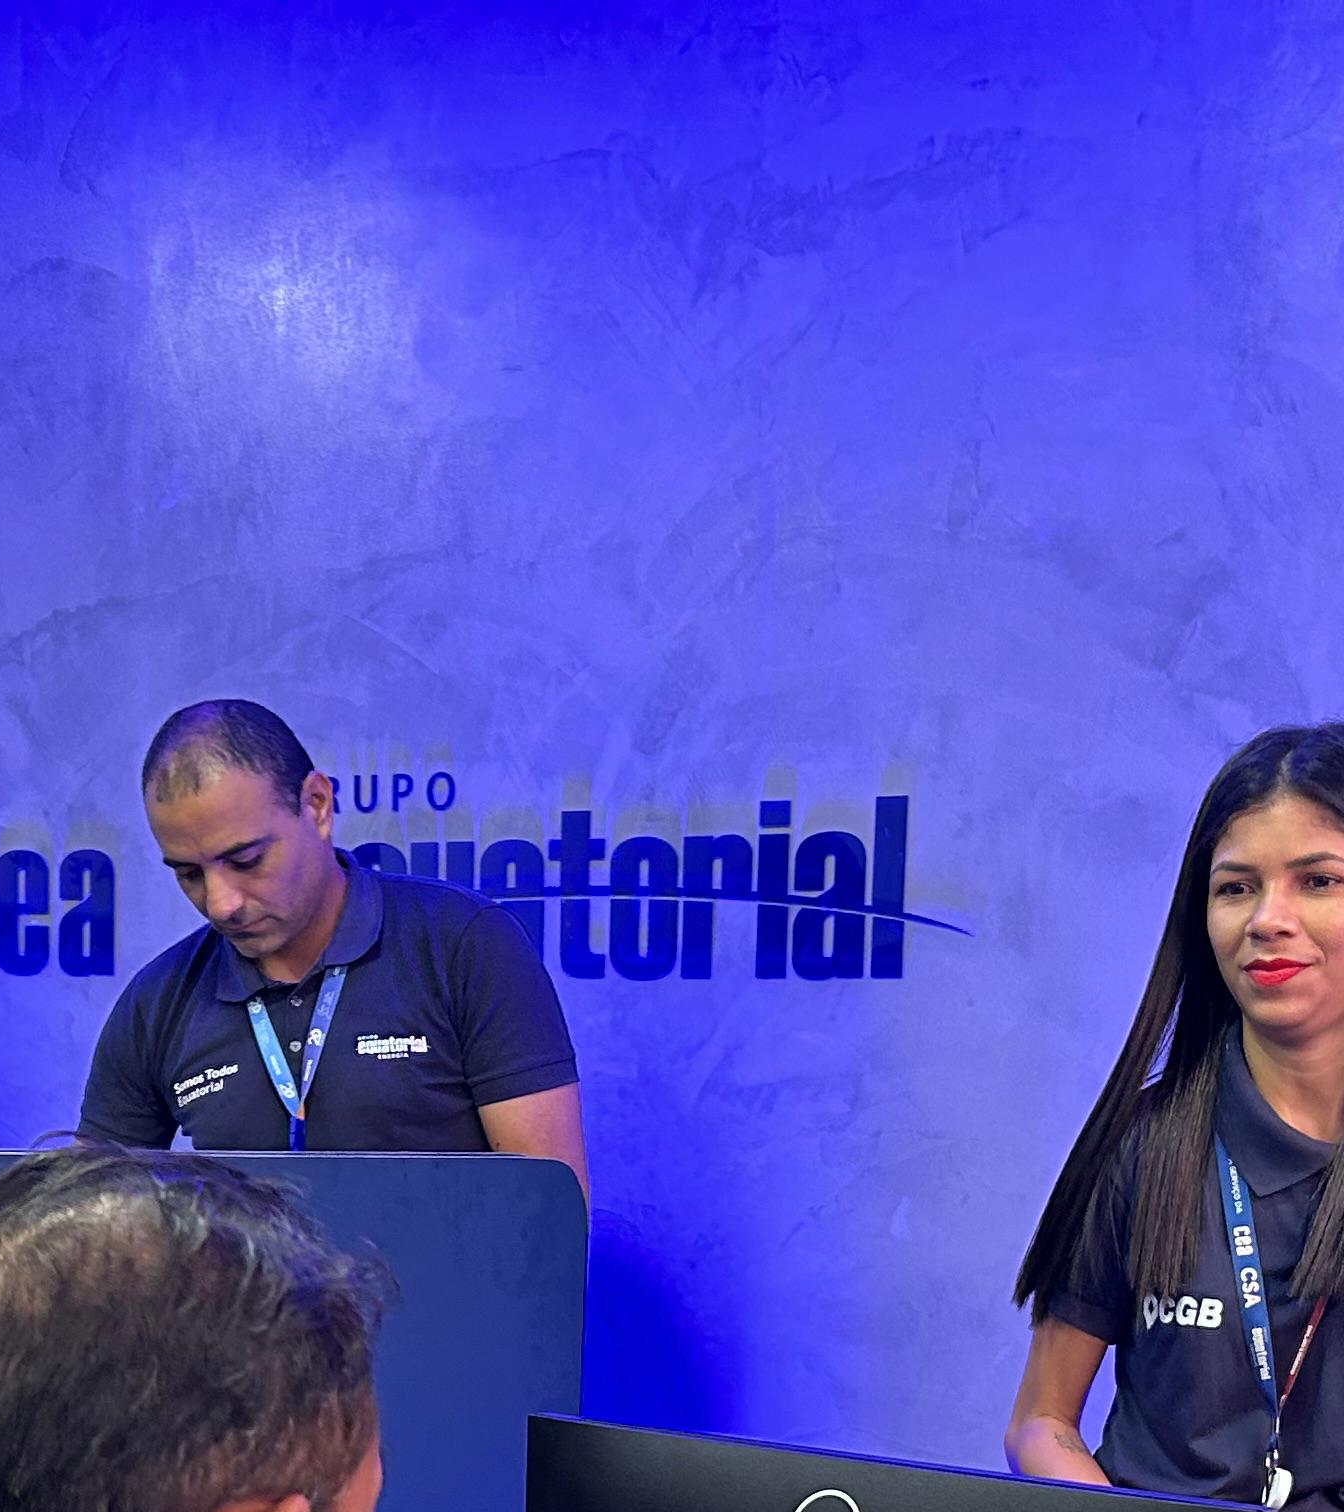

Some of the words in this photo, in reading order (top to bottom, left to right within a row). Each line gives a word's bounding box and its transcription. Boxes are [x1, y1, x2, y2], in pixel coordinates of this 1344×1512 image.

[332, 771, 456, 813] UPO
[173, 1073, 205, 1095] Somos
[204, 1064, 239, 1081] Todos
[177, 1078, 224, 1108] Equatorial
[1232, 1225, 1255, 1257] cea
[1239, 1266, 1262, 1310] CSA
